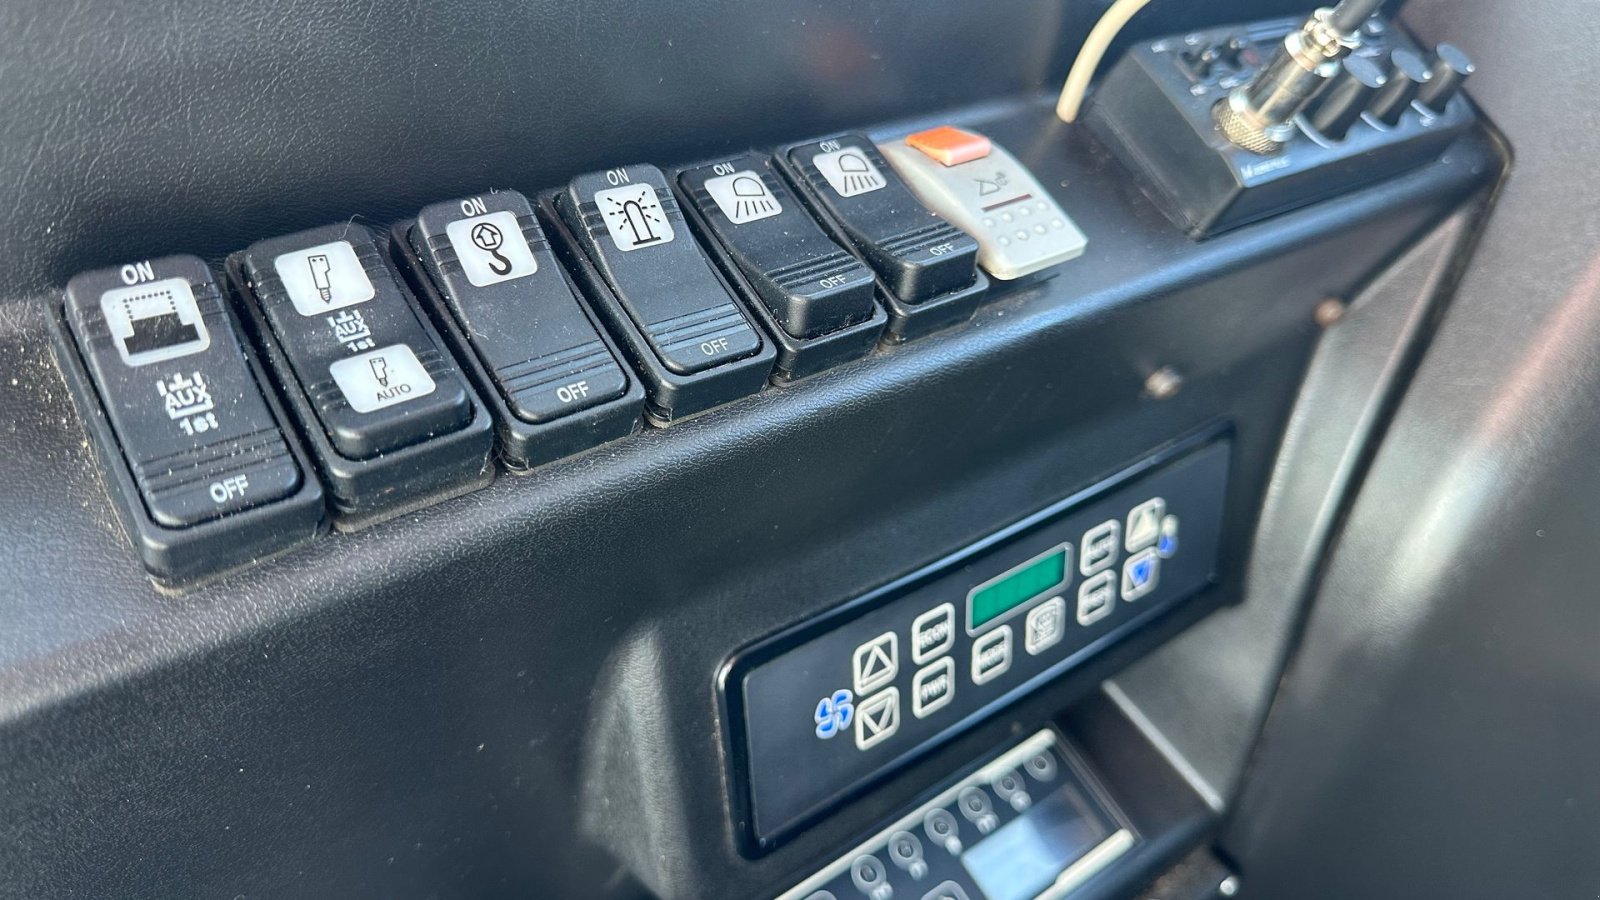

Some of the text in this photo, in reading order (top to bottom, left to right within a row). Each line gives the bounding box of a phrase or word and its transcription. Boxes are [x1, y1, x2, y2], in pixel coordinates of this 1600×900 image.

[820, 140, 841, 153] ON
[606, 167, 631, 186] ON
[713, 161, 736, 177] ON
[461, 197, 487, 217] ON
[929, 242, 956, 257] OFF
[121, 260, 155, 285] ON
[819, 273, 847, 290] OFF
[335, 317, 369, 338] AUX
[700, 337, 729, 356] OFF
[165, 383, 212, 412] AUX
[376, 383, 412, 402] AUTO
[556, 380, 590, 403] OFF
[209, 474, 249, 504] OFF
